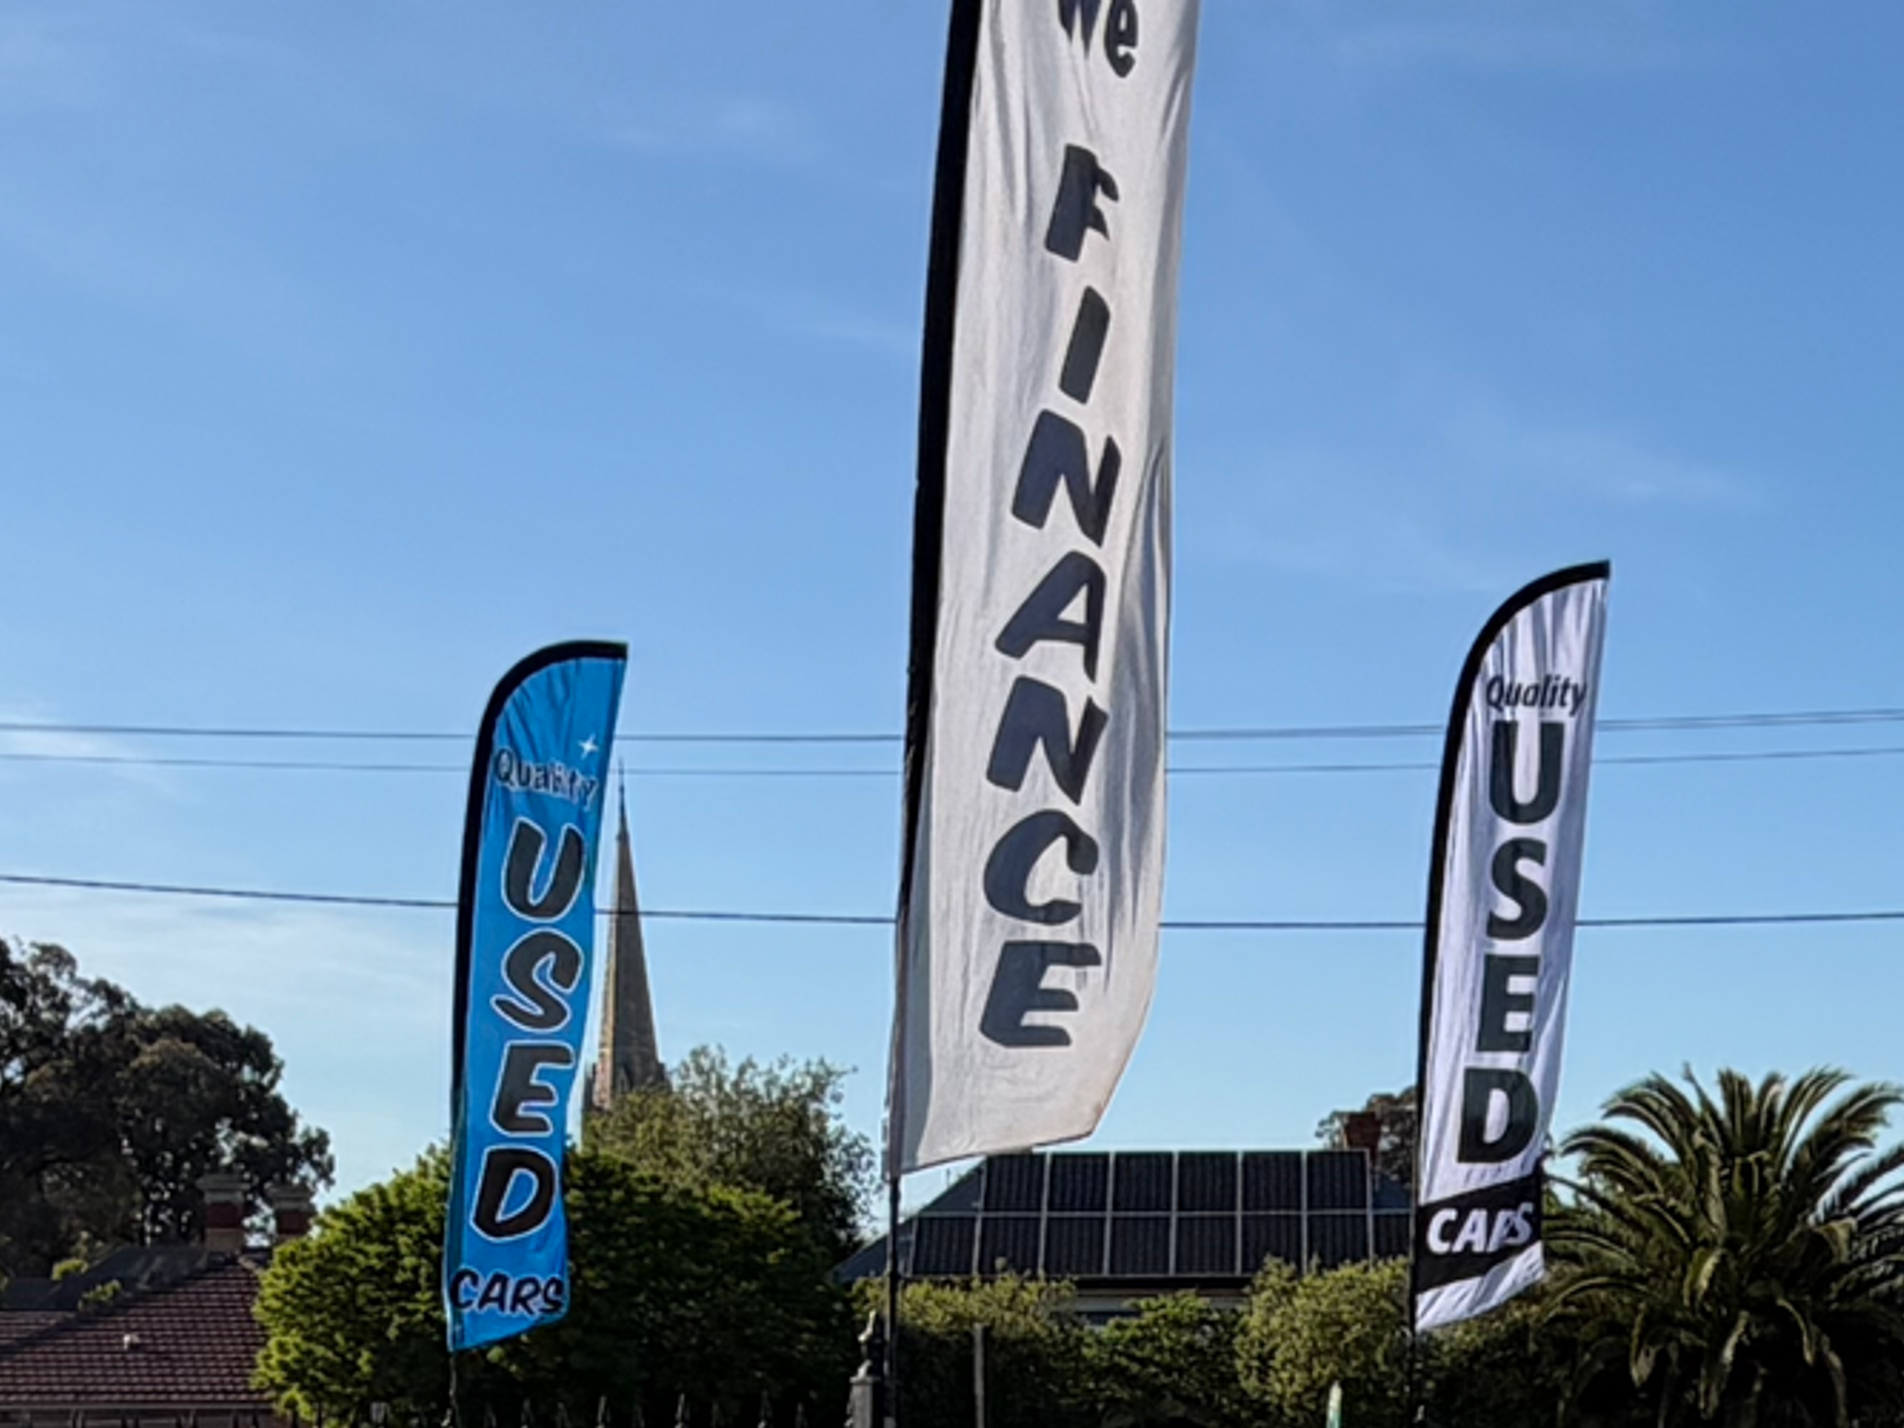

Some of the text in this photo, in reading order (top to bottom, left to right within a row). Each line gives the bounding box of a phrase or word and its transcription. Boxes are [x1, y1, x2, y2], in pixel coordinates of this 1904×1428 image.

[979, 143, 1122, 1049] FINANCE
[1486, 674, 1587, 718] Quality
[496, 747, 597, 811] Quality
[470, 817, 586, 1242] USED
[1457, 720, 1565, 1163] USED
[449, 1265, 566, 1317] CARS
